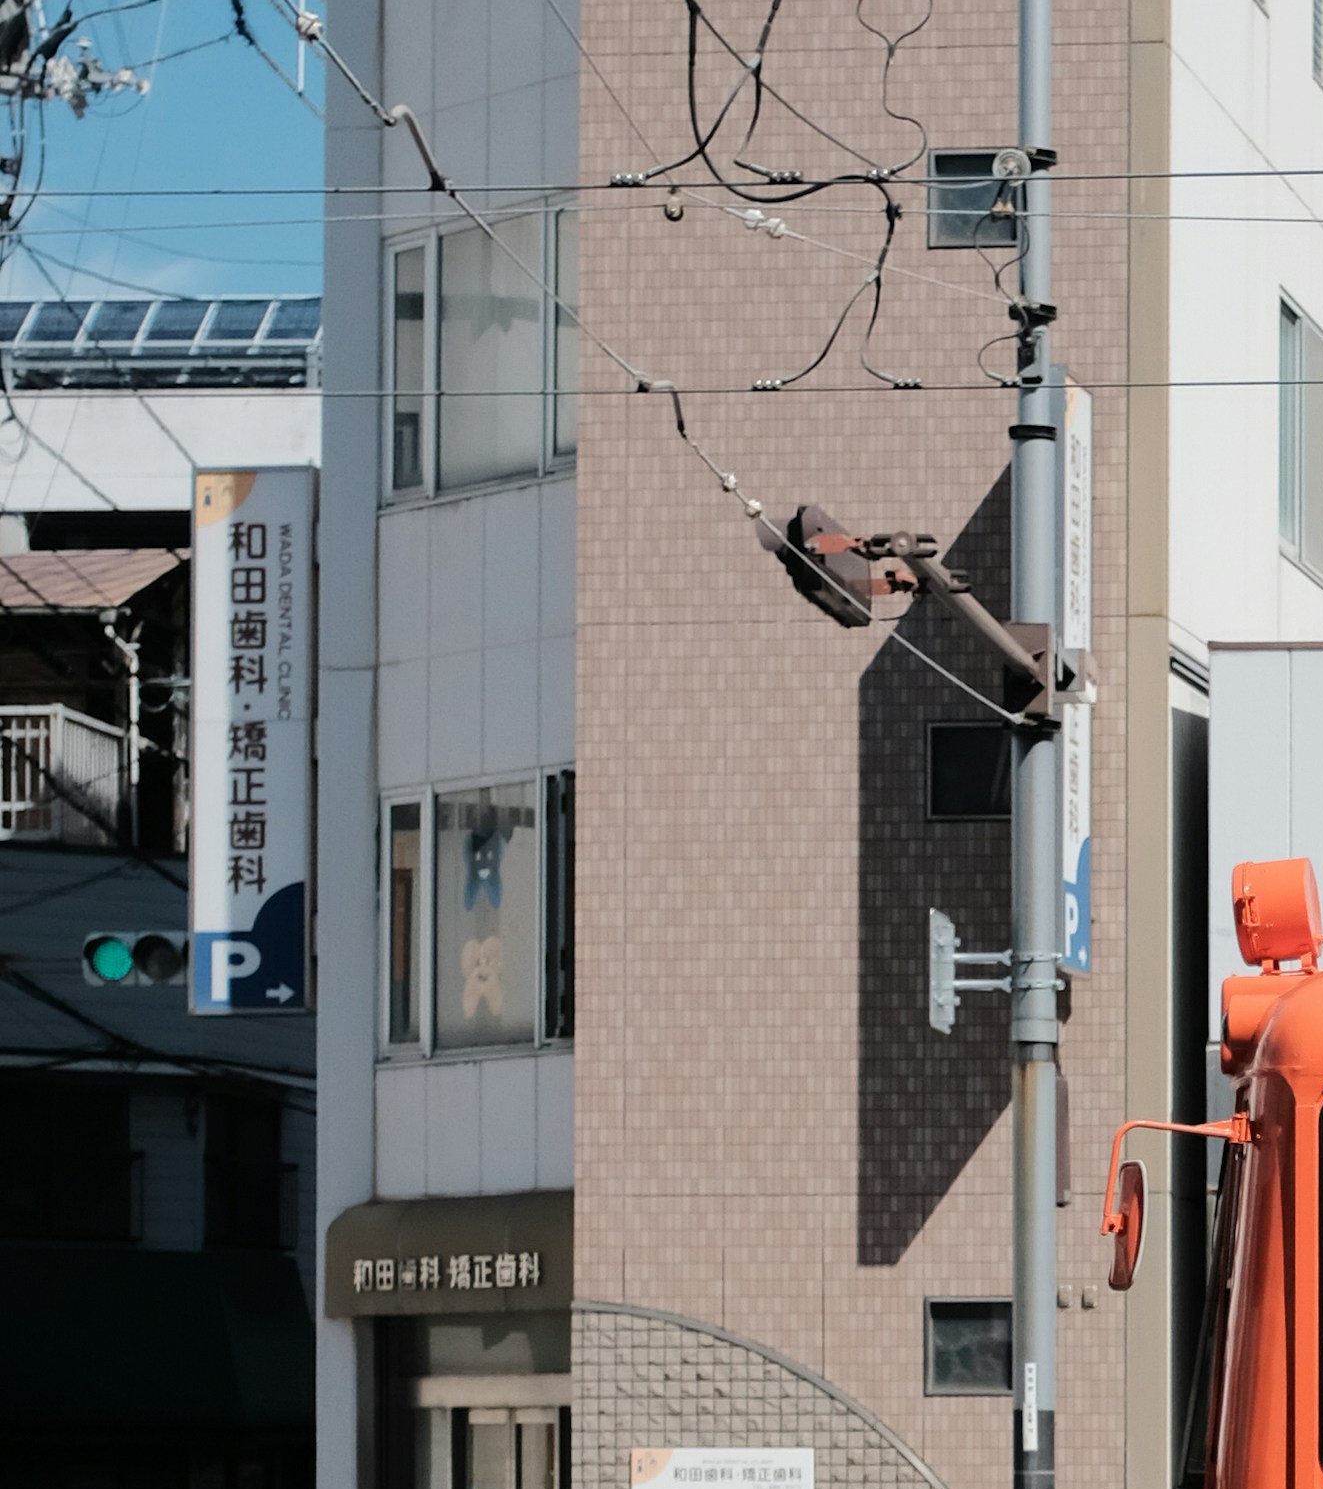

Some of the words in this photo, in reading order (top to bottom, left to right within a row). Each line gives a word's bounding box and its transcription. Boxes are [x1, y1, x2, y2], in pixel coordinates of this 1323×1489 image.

[278, 523, 292, 578] WADA
[278, 582, 292, 655] DENTAL
[229, 522, 268, 894] 和田歯科・矯正歯科
[278, 661, 292, 722] CLINIC
[210, 939, 262, 1002] P
